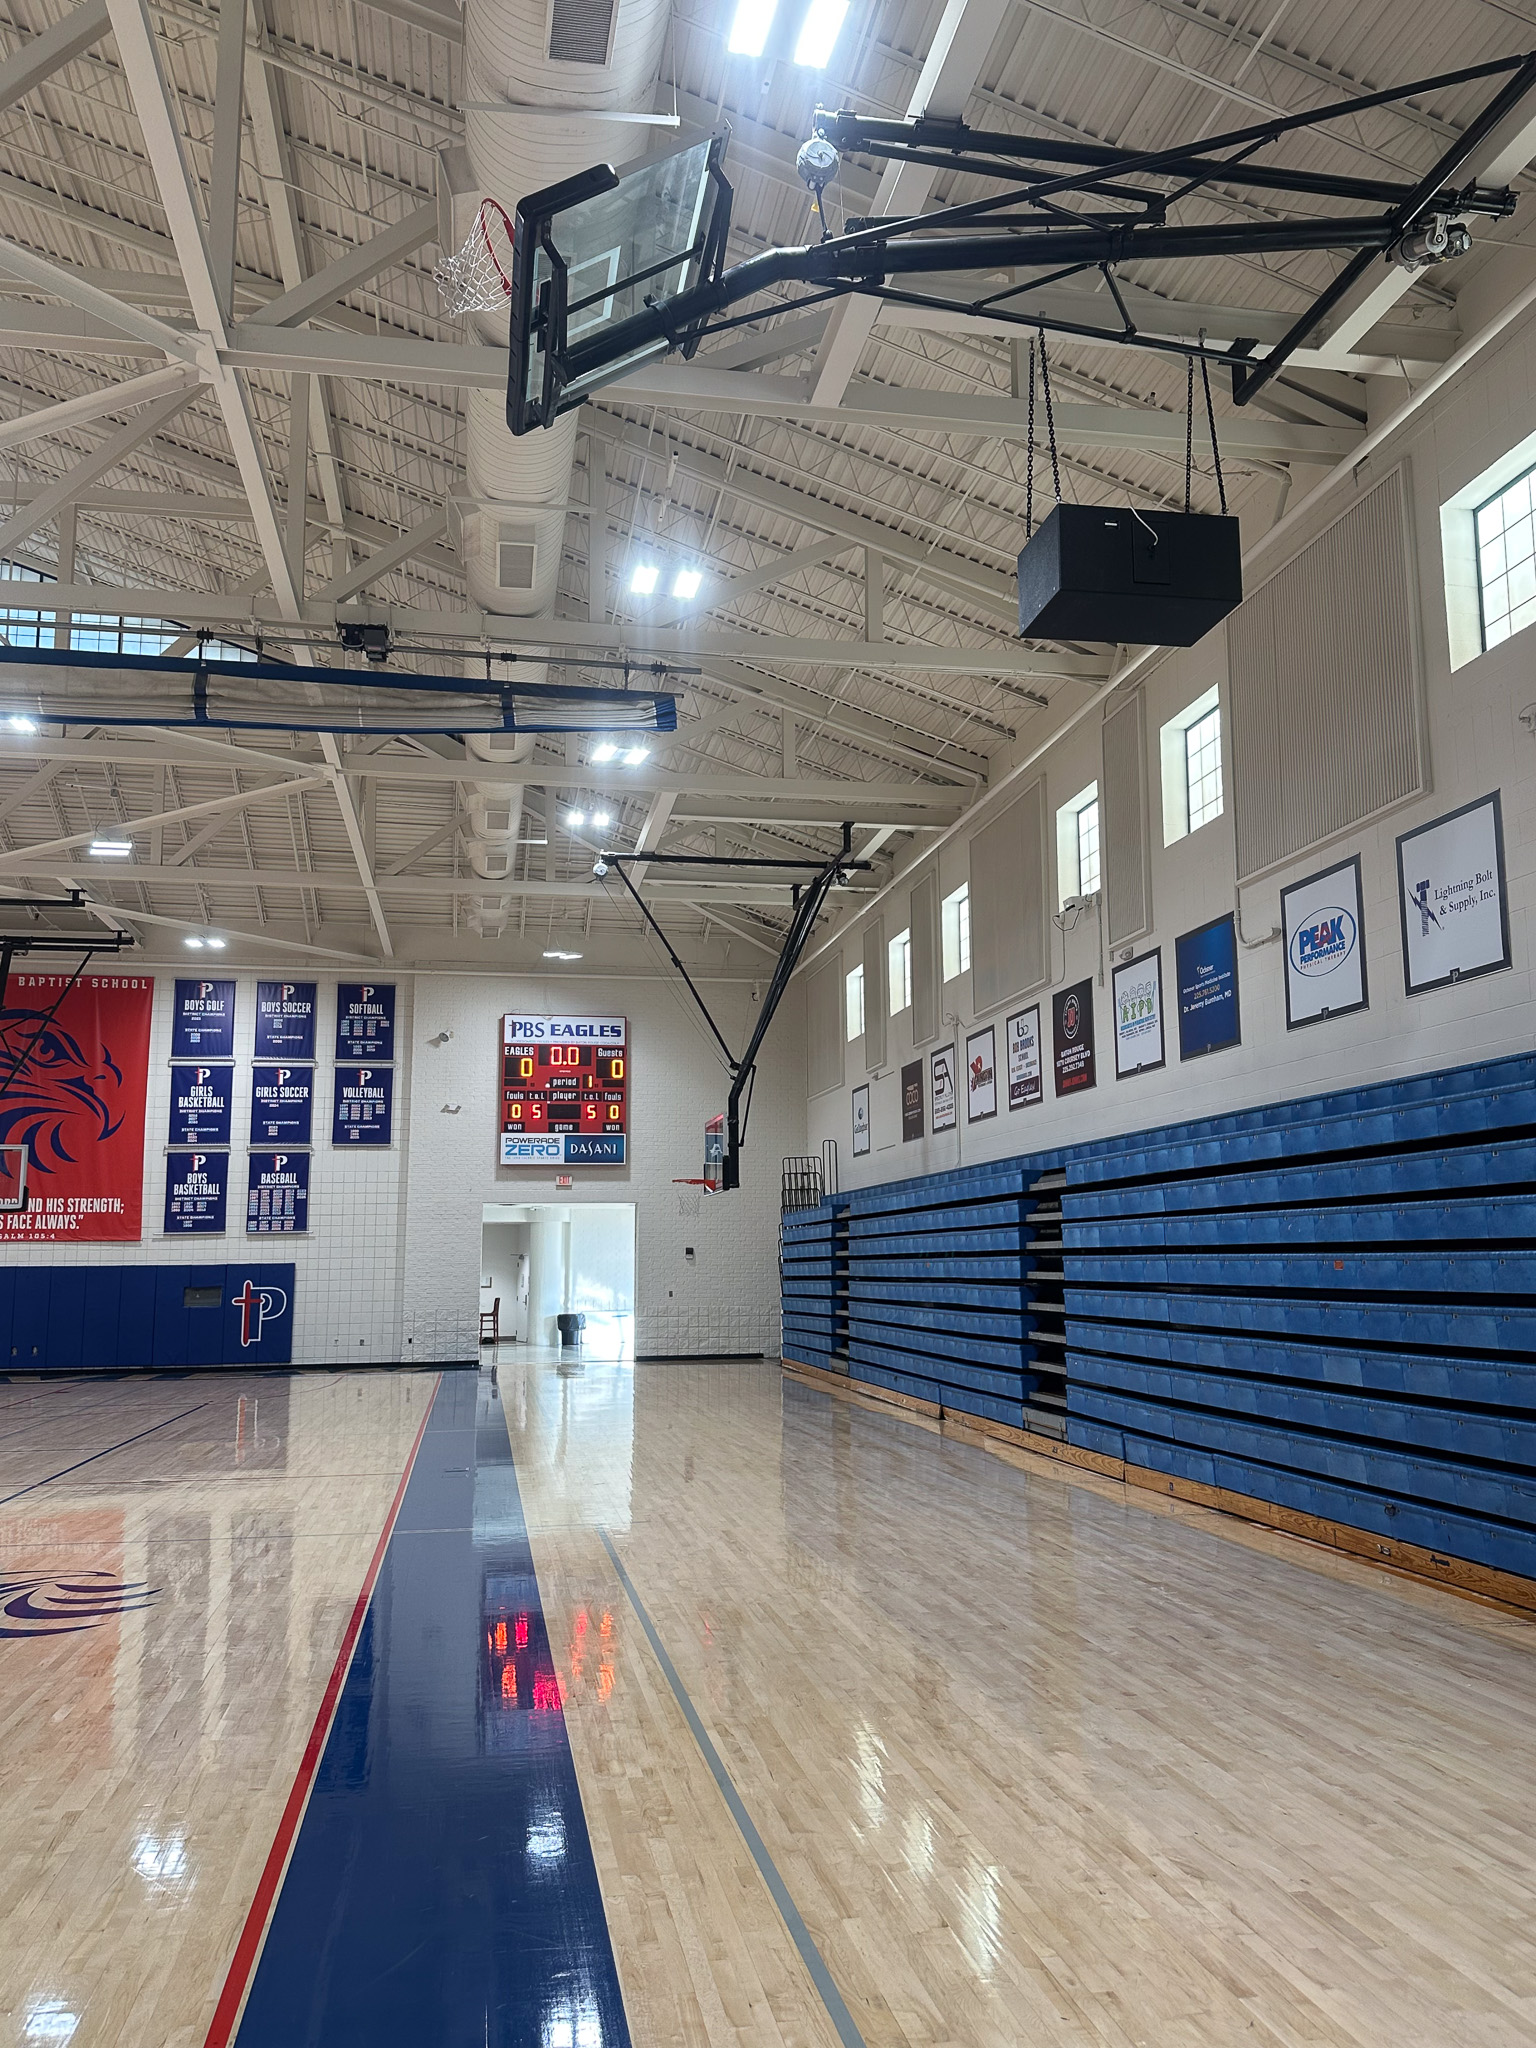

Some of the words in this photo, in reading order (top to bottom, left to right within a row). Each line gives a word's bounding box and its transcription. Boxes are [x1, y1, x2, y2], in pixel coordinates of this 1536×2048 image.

[1434, 879, 1474, 900] Lightning
[1475, 869, 1493, 886] Bolt
[1439, 906, 1447, 916] &
[1448, 894, 1478, 912] Supply,
[1480, 888, 1496, 902] Inc.
[1299, 915, 1345, 955] PEAK
[1300, 941, 1346, 965] PERFORMANCE
[1300, 961, 1323, 970] PHYSICAL
[1325, 951, 1346, 961] THERAPY
[18, 976, 82, 988] BAPTIST
[91, 978, 148, 990] SCHOOL
[184, 1000, 204, 1011] BOYS
[206, 1000, 225, 1011] GOLF
[261, 1002, 280, 1013] BOYS
[282, 1002, 311, 1013] SOCCER
[349, 1003, 383, 1014] SOFTBALL
[508, 1020, 545, 1038] PBS
[550, 1024, 622, 1037] EAGLES
[504, 1046, 535, 1056] EAGLES
[550, 1046, 579, 1065] 0.0
[598, 1048, 623, 1057] Guests
[520, 1058, 533, 1077] 0
[611, 1059, 624, 1078] 0
[552, 1077, 577, 1087] period
[588, 1075, 593, 1088] 1
[190, 1086, 213, 1097] GIRLS
[256, 1086, 278, 1098] GIRLS
[280, 1086, 309, 1098] SOCCER
[343, 1087, 385, 1098] VOLLEYBALL
[506, 1091, 524, 1100] fouls
[552, 1091, 577, 1101] player
[604, 1092, 622, 1101] fouls
[178, 1097, 225, 1108] BASKETBALL
[511, 1104, 521, 1118] 0
[532, 1104, 541, 1119] 5
[587, 1105, 596, 1119] 5
[610, 1105, 619, 1119] 0
[554, 1123, 574, 1132] game
[505, 1144, 560, 1156] ZERO
[570, 1141, 617, 1156] DASANI
[187, 1173, 207, 1184] BOYS
[261, 1173, 297, 1184] BASEBALL
[174, 1184, 220, 1195] BASKETBALL
[26, 1197, 43, 1213] ND
[46, 1197, 64, 1213] HIS
[67, 1197, 124, 1215] STRENGTH;
[7, 1214, 33, 1230] FACE
